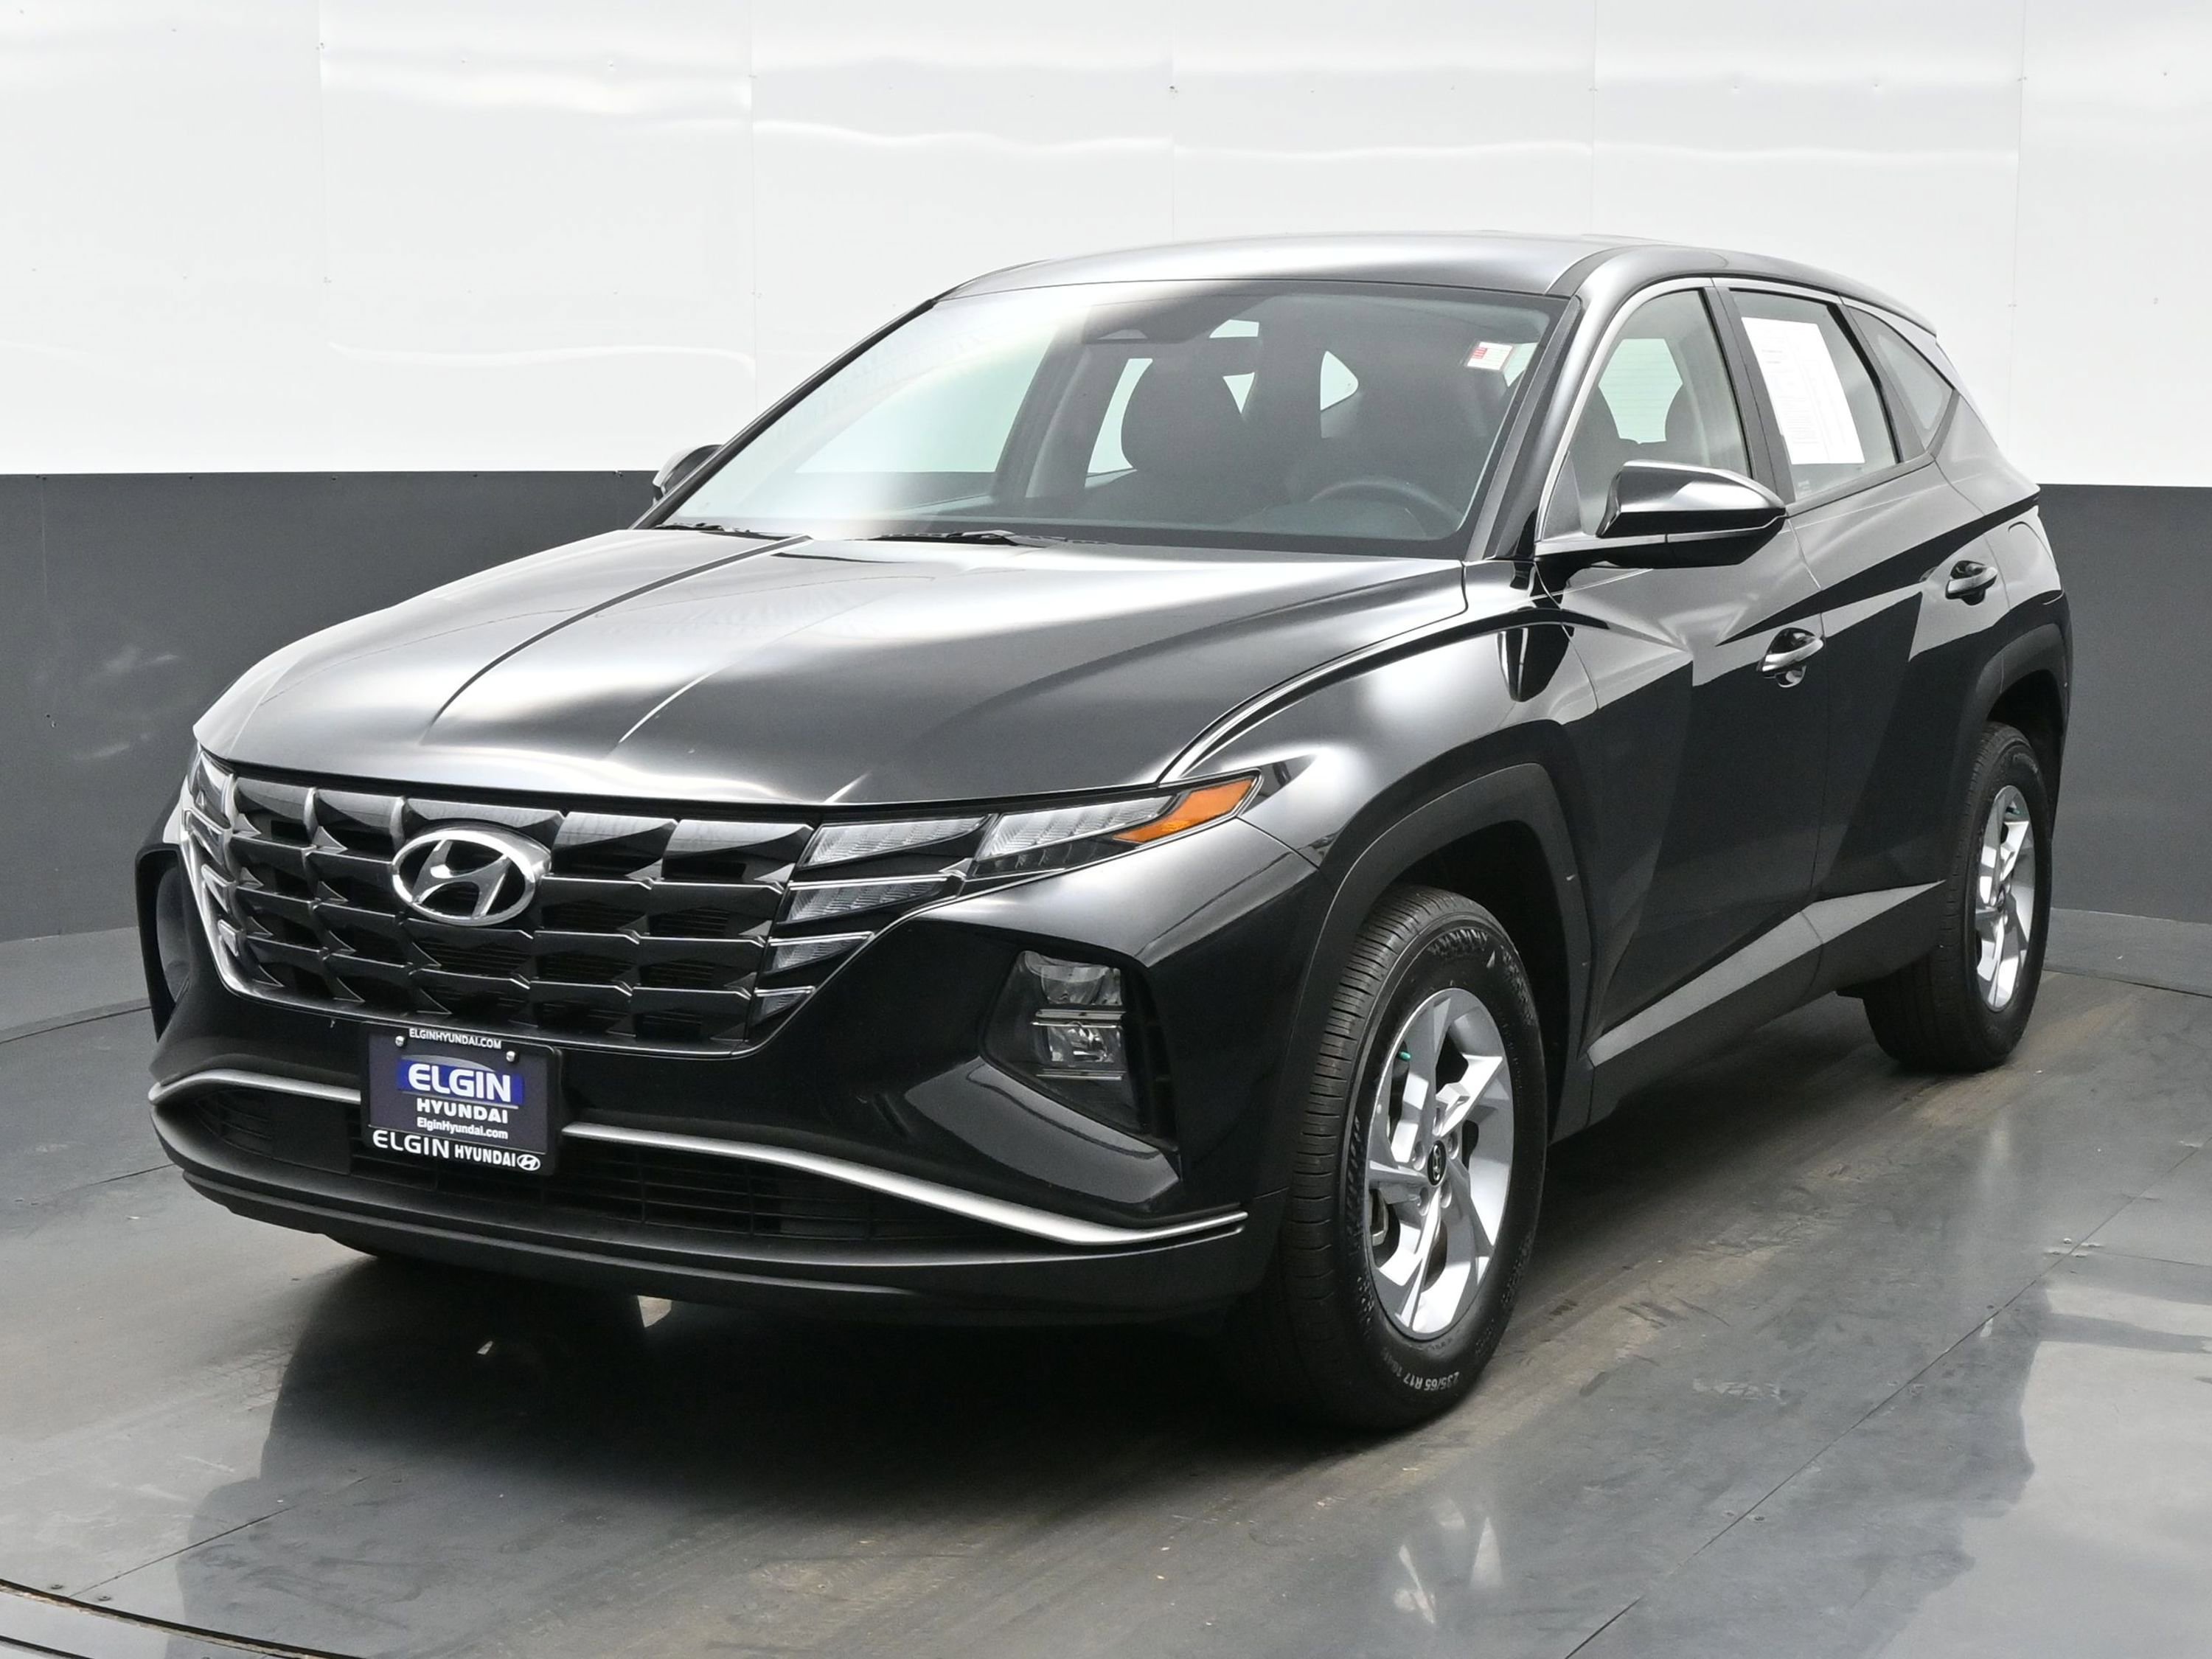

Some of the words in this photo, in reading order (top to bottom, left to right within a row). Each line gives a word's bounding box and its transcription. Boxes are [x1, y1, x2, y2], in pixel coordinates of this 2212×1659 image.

[409, 1028, 501, 1049] ELGINHYUNDAI.COM
[408, 1063, 511, 1102] ELGIN
[417, 1098, 508, 1124] HYUNDAI
[417, 1117, 508, 1139] ElginHyundai.com
[372, 1130, 449, 1158] ELGIN
[455, 1144, 515, 1167] HYUNDAI
[1403, 1373, 1422, 1390] R17
[1424, 1371, 1460, 1391] 235/65
